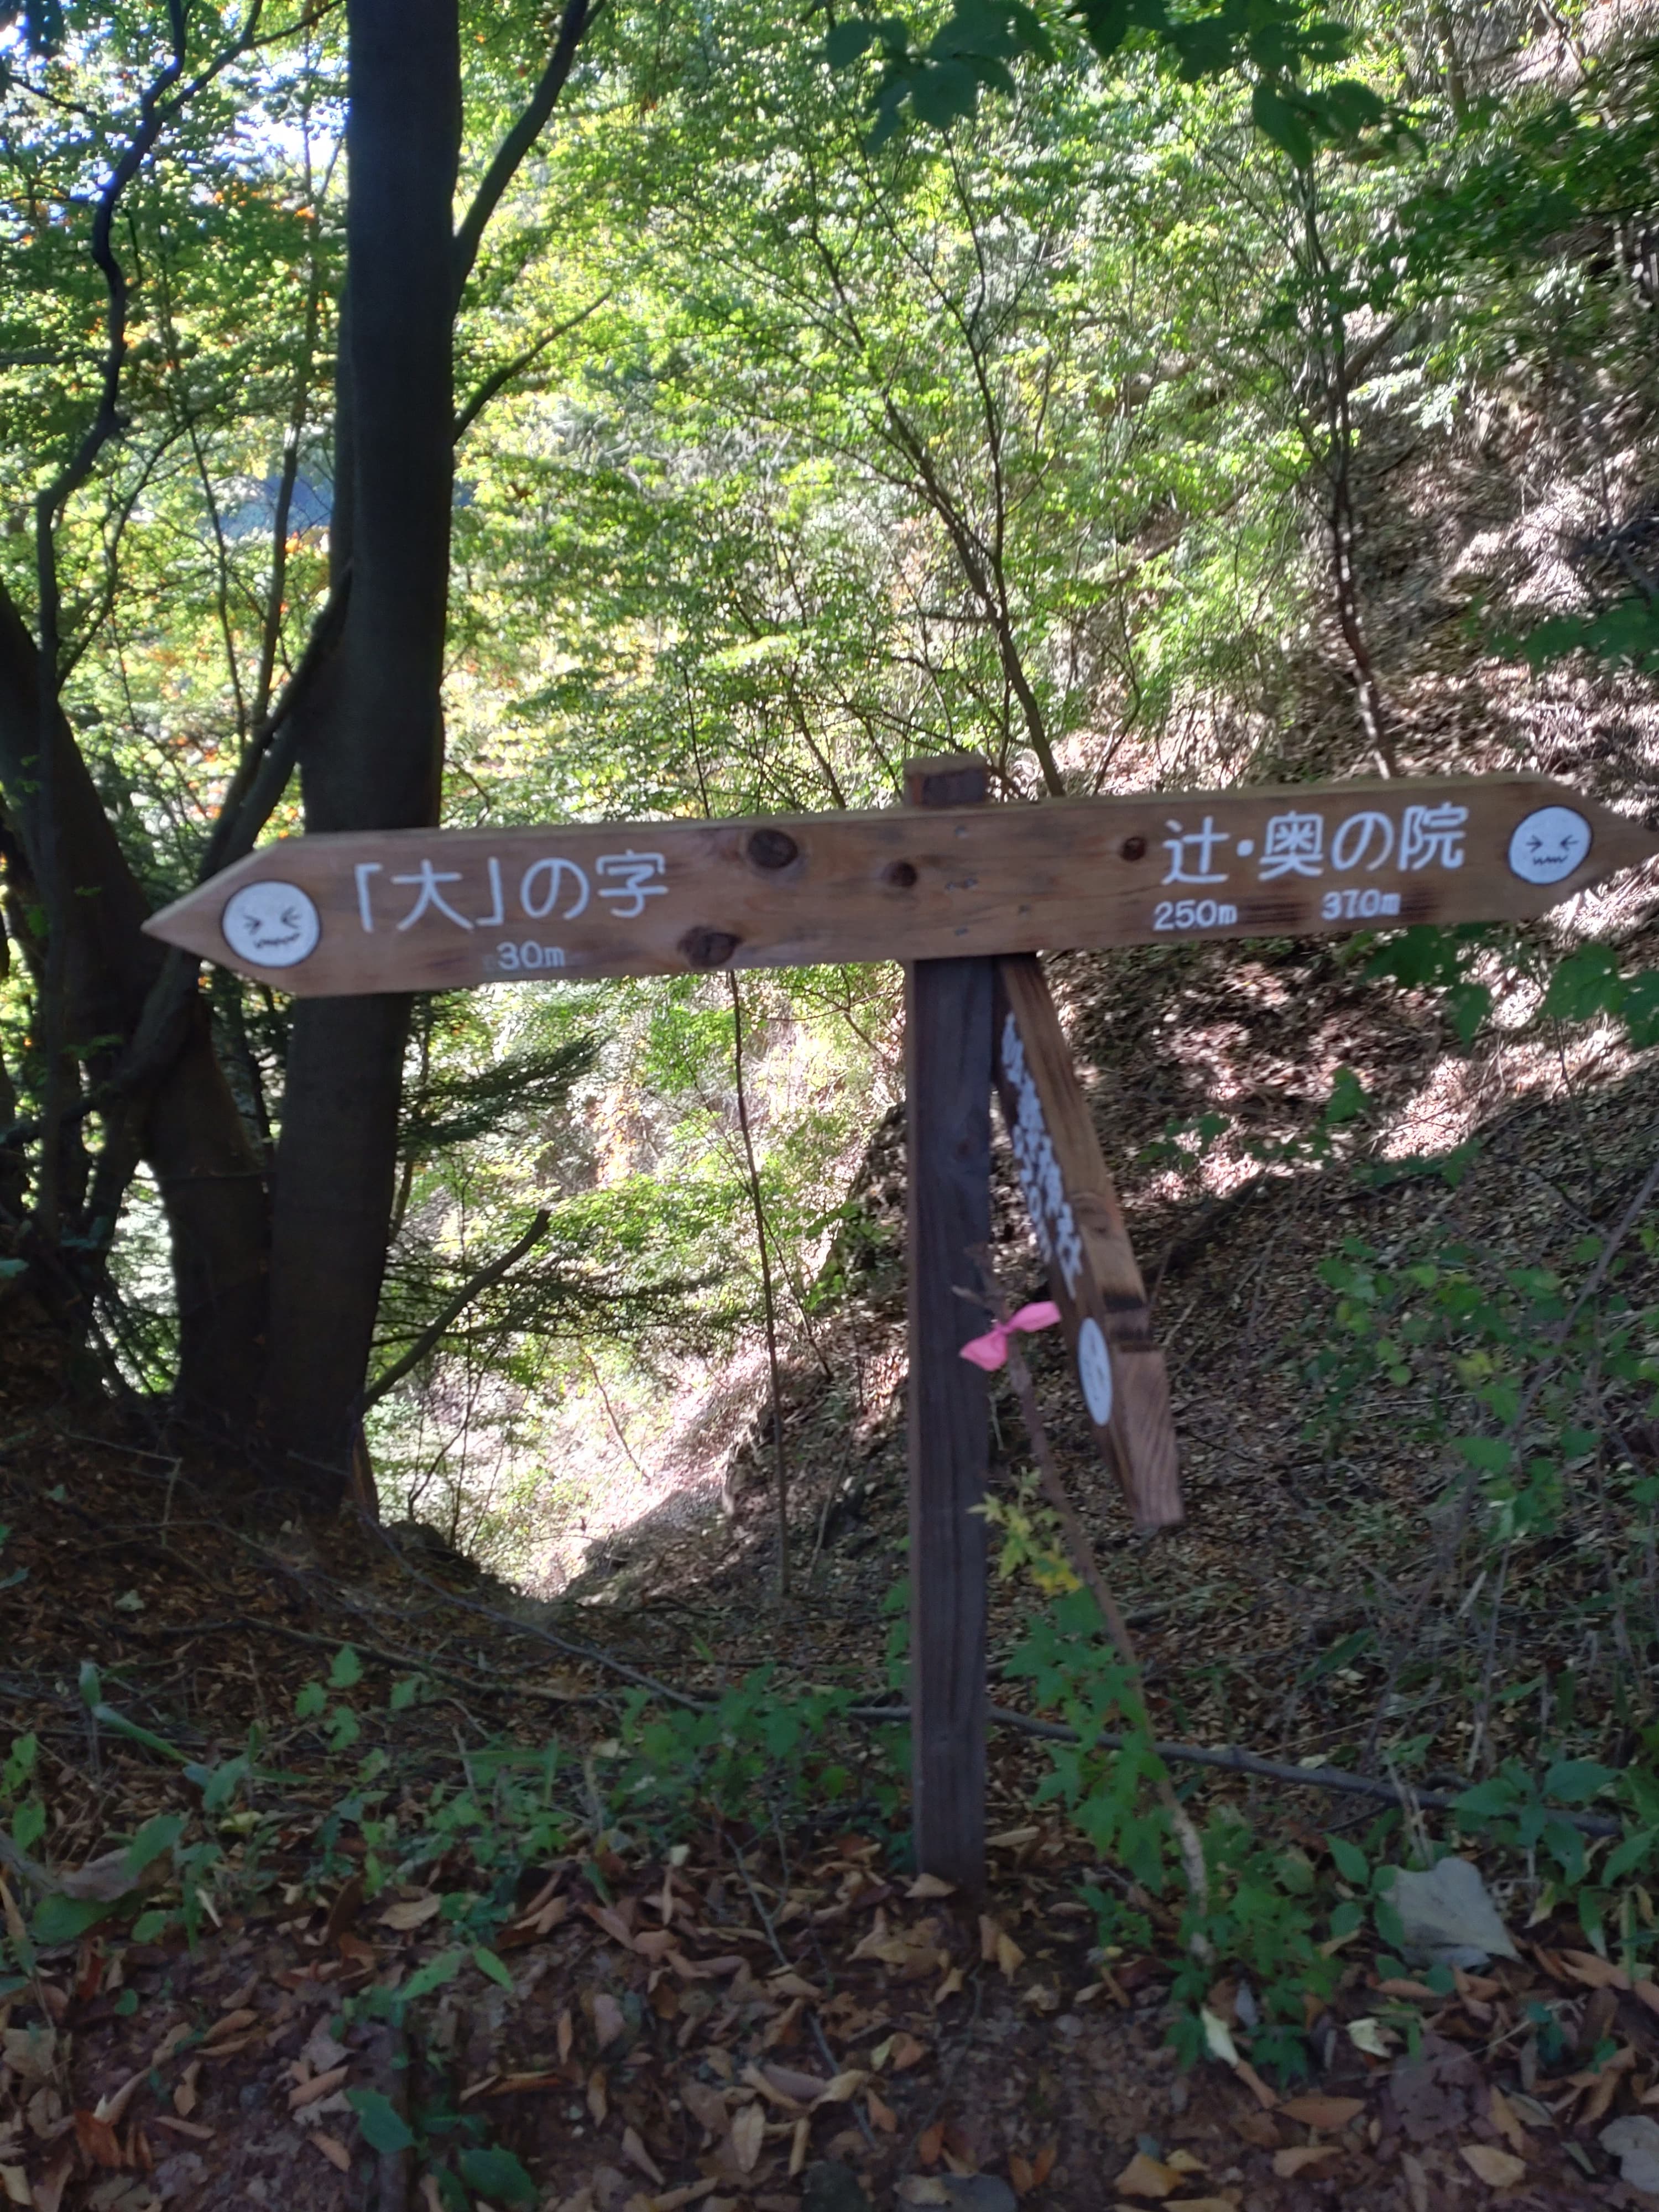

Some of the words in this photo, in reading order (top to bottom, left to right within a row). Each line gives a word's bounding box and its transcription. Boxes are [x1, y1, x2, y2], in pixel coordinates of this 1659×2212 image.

[1162, 802, 1469, 884] 辻・奥の院
[354, 849, 667, 933] 「大」の字
[1154, 899, 1238, 931] 250m
[1323, 889, 1401, 920] 370m
[497, 941, 566, 971] 30m
